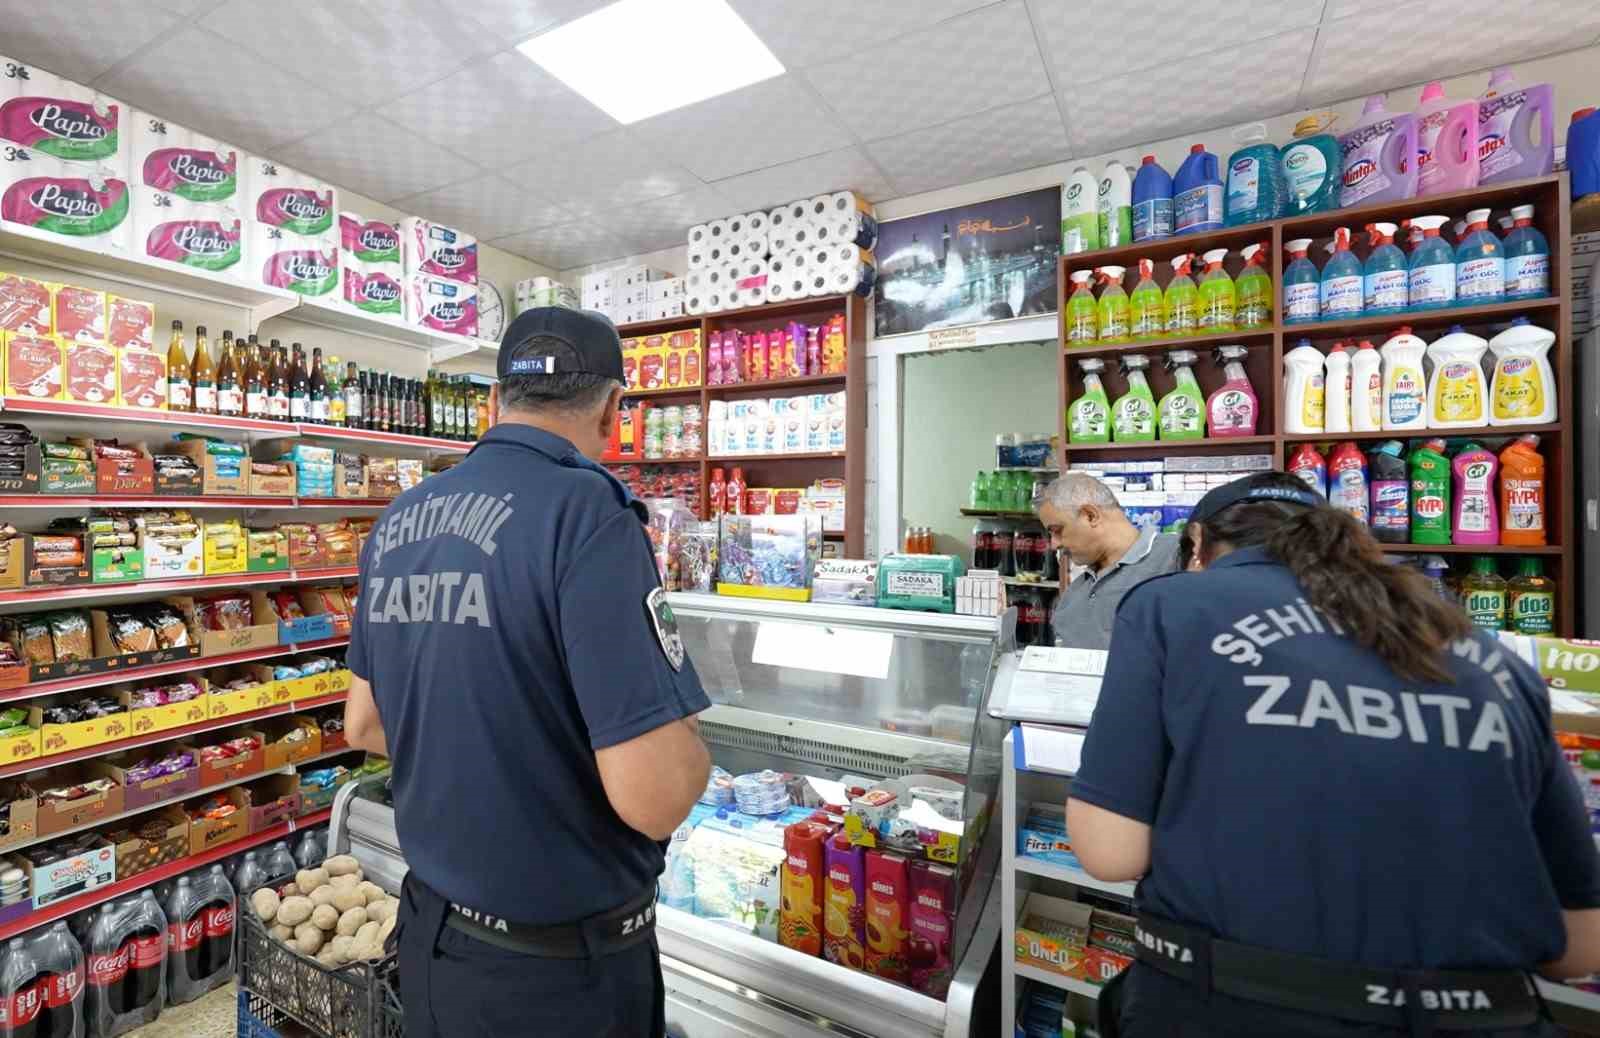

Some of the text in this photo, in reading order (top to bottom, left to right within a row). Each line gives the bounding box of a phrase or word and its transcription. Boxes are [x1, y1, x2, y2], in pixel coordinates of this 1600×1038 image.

[38, 104, 103, 138] Papia
[1478, 136, 1506, 157] ntax
[175, 154, 226, 184] Papia
[38, 183, 99, 216] Papia
[283, 193, 325, 219] Papia
[179, 226, 229, 254] Papia
[362, 230, 396, 250] Papia
[288, 257, 330, 281] Papia
[364, 282, 399, 301] Papia
[512, 359, 543, 370] ZABITA
[1467, 464, 1487, 478] Cif
[1250, 487, 1301, 500] ZABITA
[373, 491, 515, 569] ŞEHİTKAMİL
[896, 575, 934, 585] SADAKA
[368, 571, 492, 628] ZABITA
[1470, 594, 1501, 611] doa
[1519, 597, 1551, 612] doa
[1242, 675, 1514, 760] ZABITA
[1025, 838, 1054, 850] First
